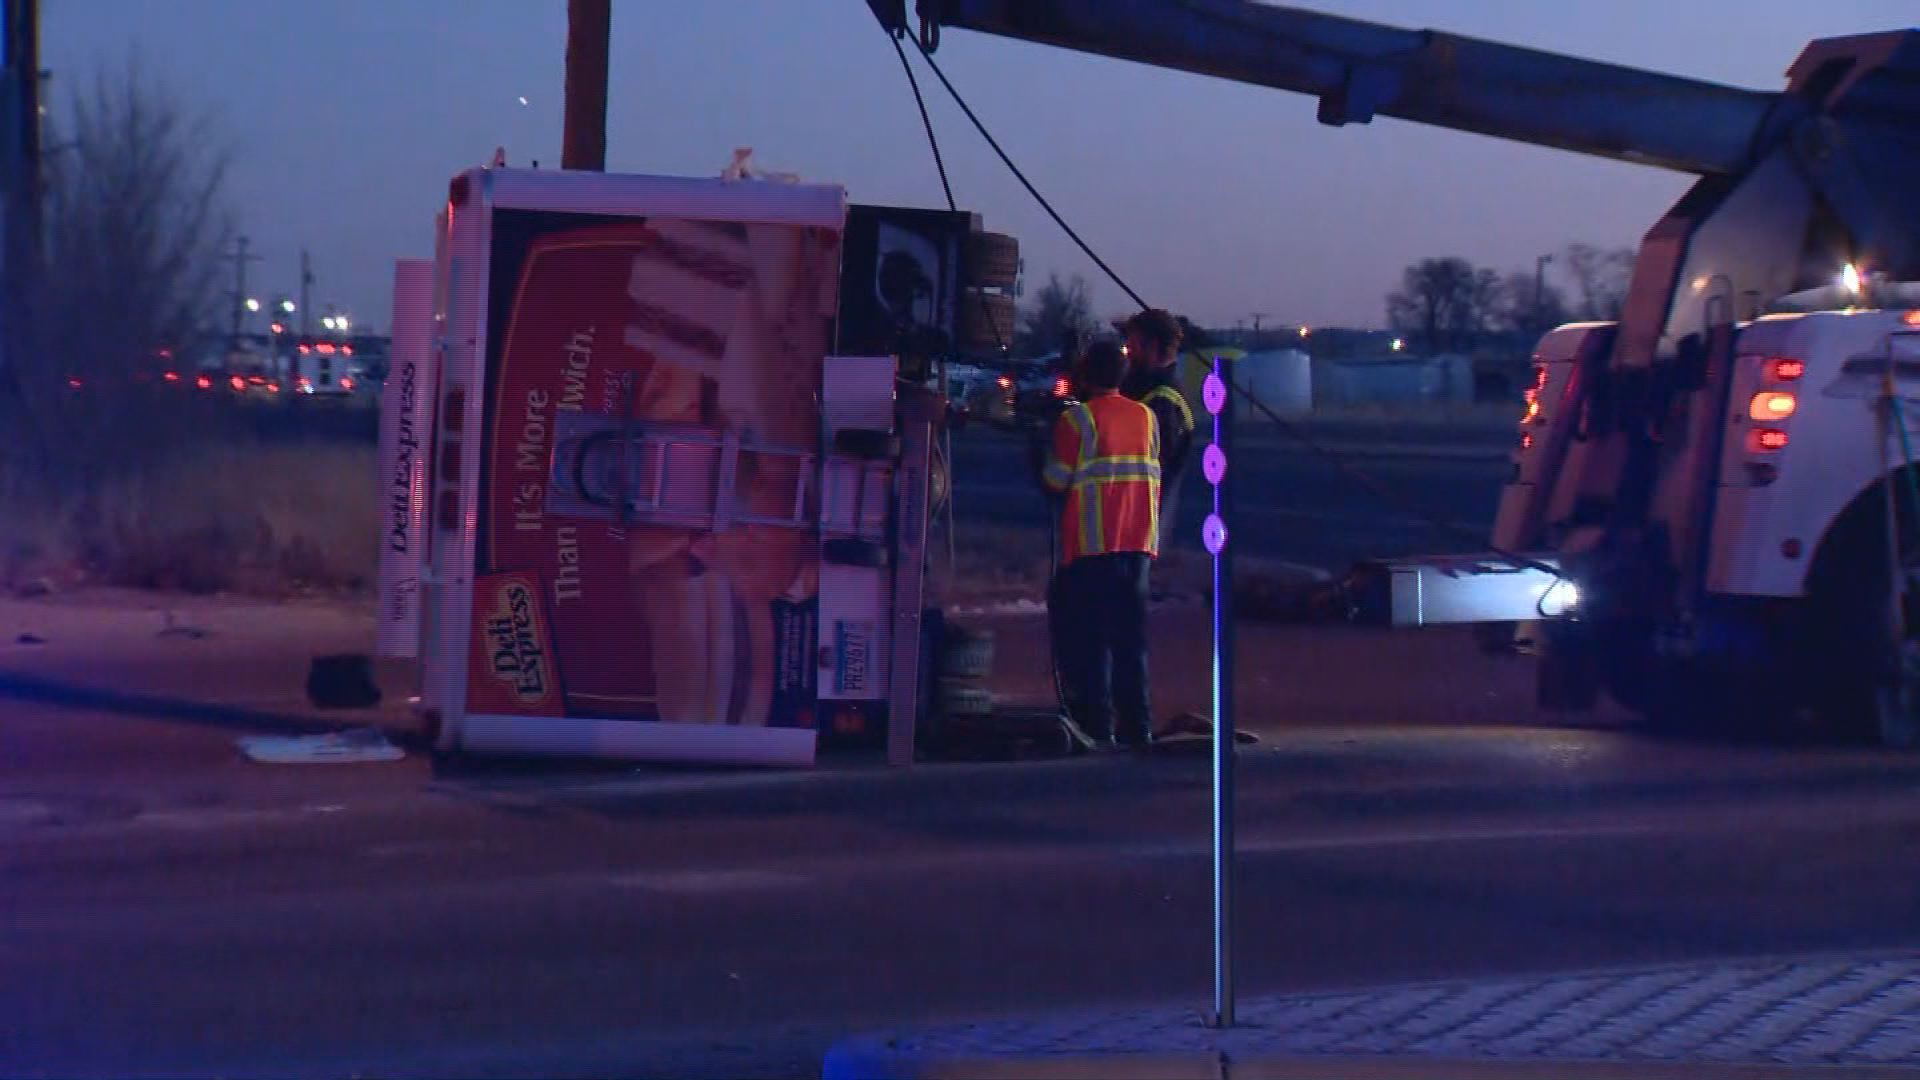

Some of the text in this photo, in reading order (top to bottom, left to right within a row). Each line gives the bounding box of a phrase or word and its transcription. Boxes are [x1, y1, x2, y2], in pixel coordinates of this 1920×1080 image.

[391, 362, 417, 553] Deli Express
[512, 388, 549, 530] It's More
[554, 527, 581, 607] Than
[487, 618, 521, 672] Deli
[506, 586, 543, 694] Express
